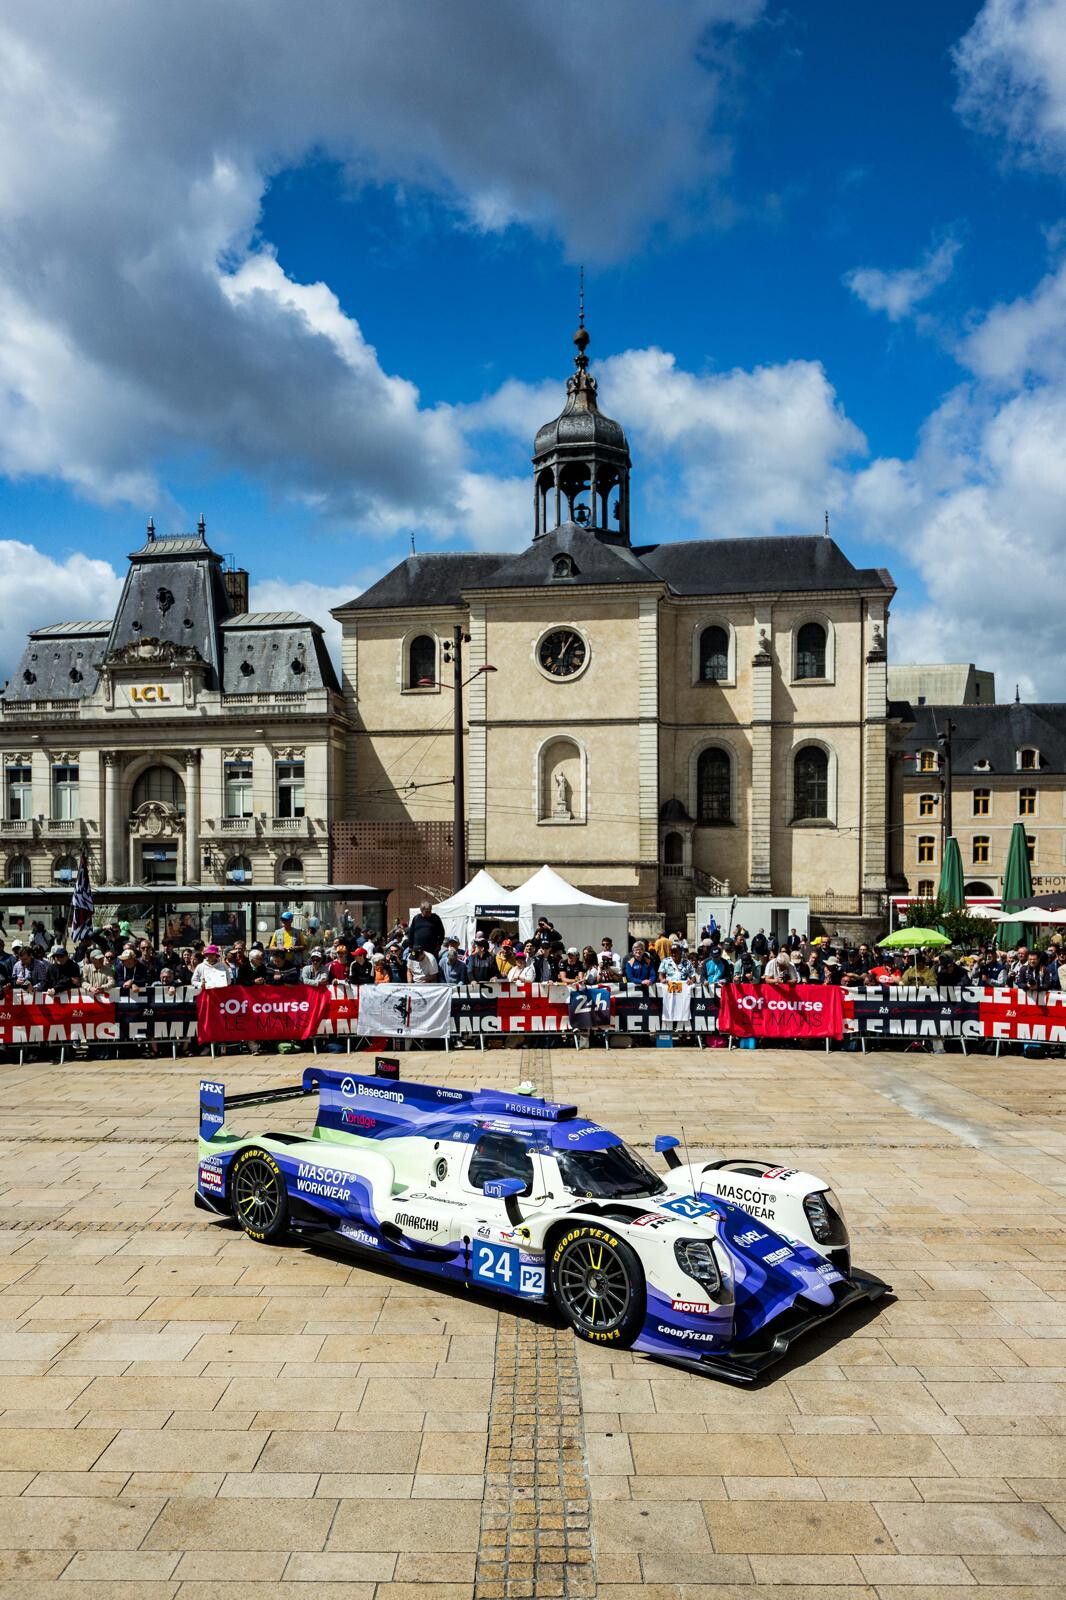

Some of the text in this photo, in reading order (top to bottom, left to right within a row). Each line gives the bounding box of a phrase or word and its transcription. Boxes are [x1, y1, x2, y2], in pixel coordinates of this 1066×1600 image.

[131, 685, 171, 702] LCL
[252, 1001, 310, 1013] course
[768, 999, 823, 1011] course
[358, 1084, 404, 1104] Basecamp
[505, 1103, 557, 1119] PROSPERITY
[201, 1170, 222, 1185] MOTUL
[296, 1178, 351, 1201] WORKWEAR
[671, 1198, 712, 1216] 24
[394, 1212, 439, 1232] OMARCHY
[341, 1224, 379, 1247] GOODYEAR
[557, 1227, 619, 1254] GOODYEAR
[478, 1246, 513, 1282] 24
[522, 1270, 543, 1289] P2
[673, 1301, 709, 1314] MOTUL
[657, 1325, 714, 1342] GOODYEAR
